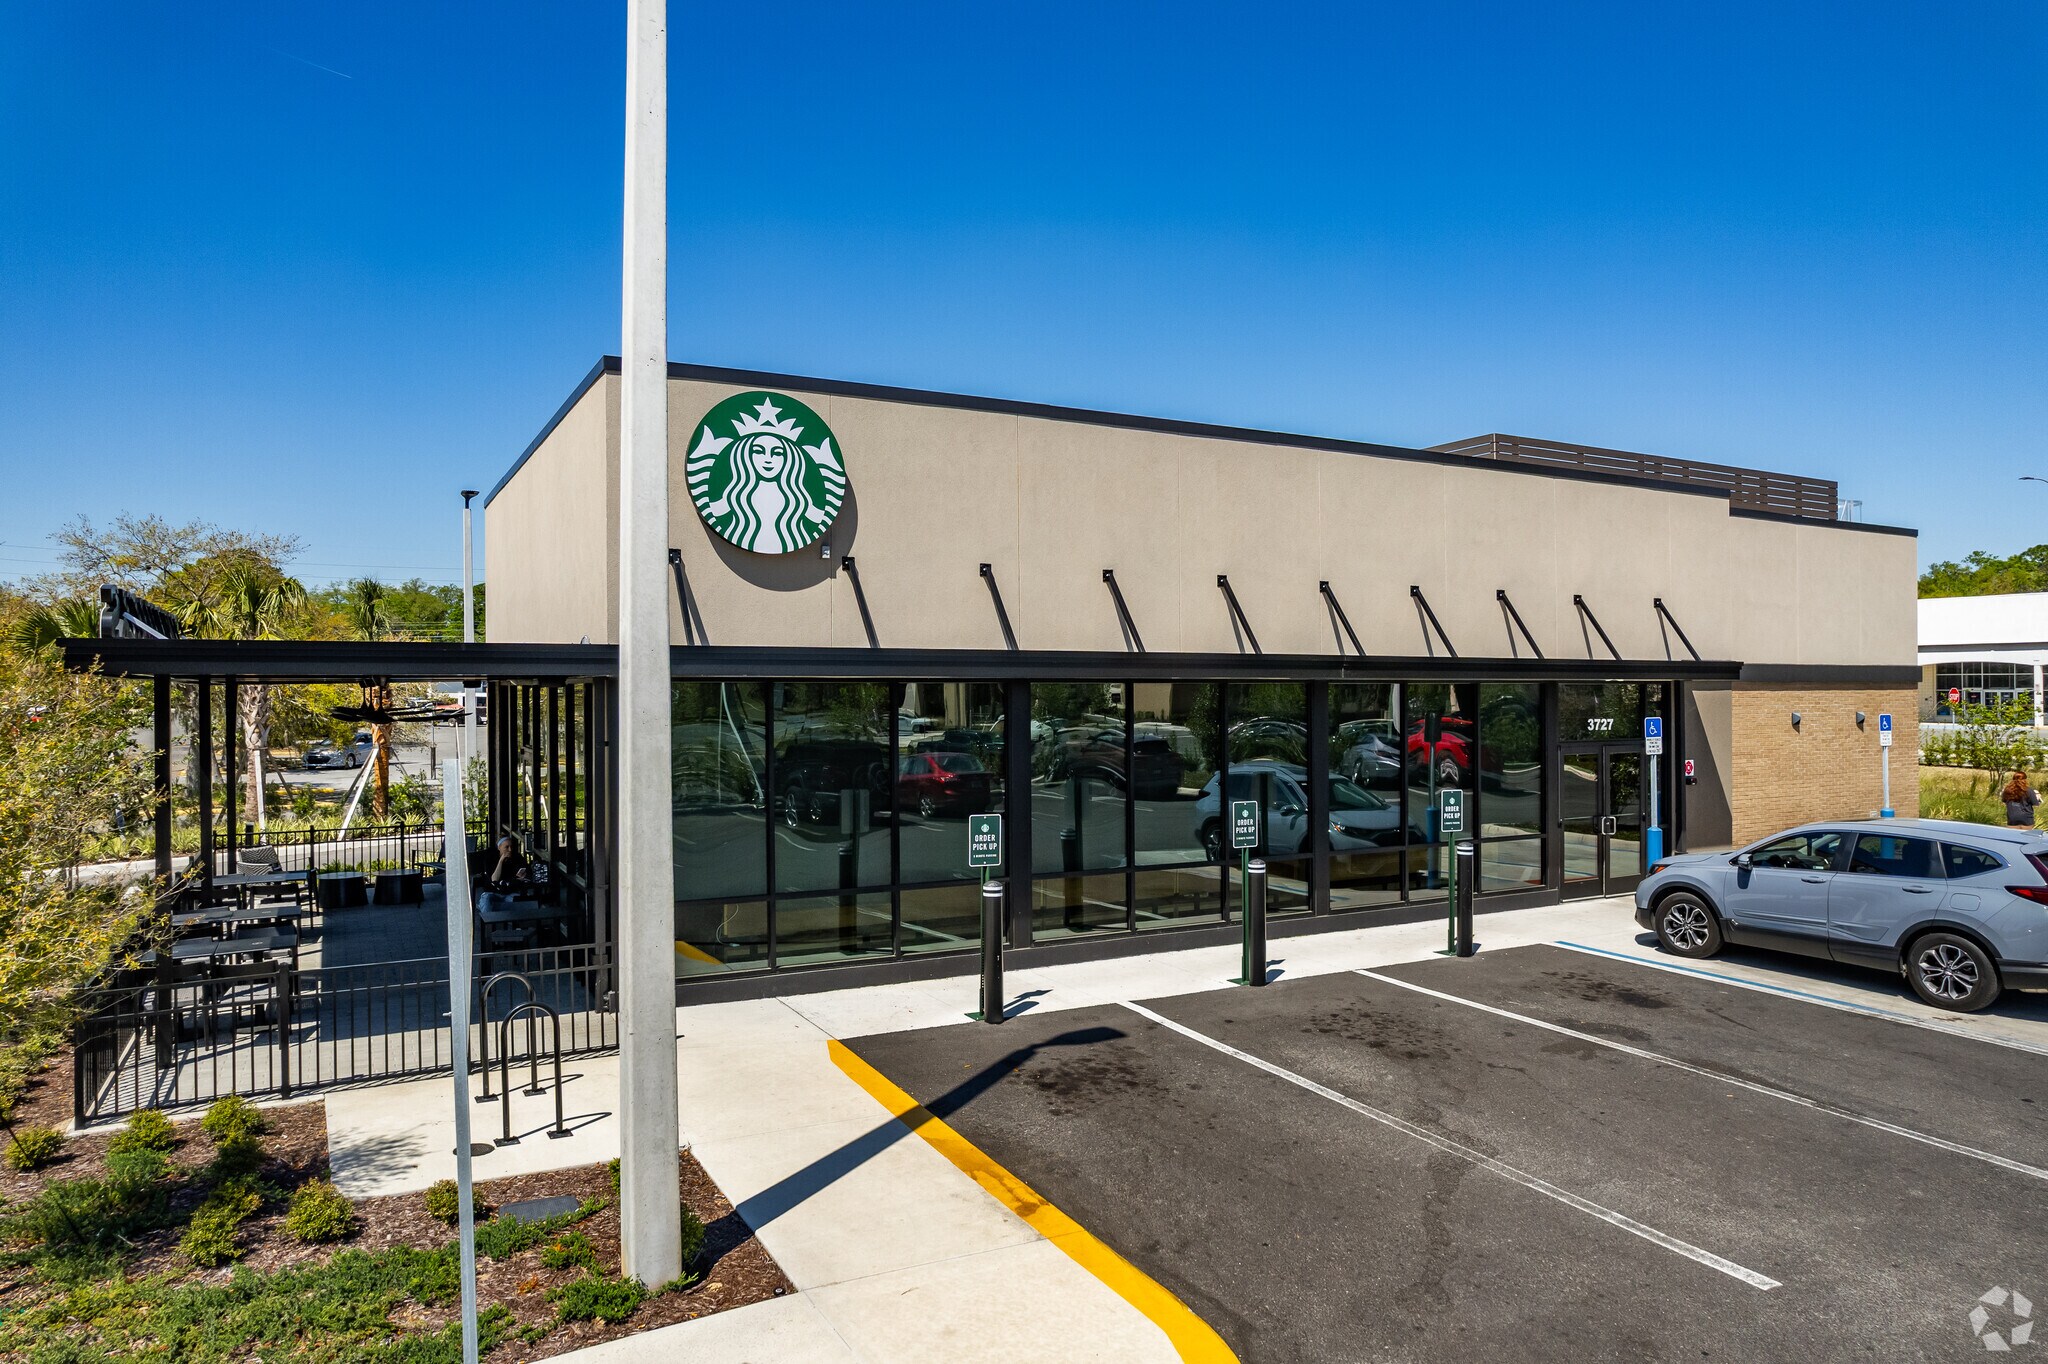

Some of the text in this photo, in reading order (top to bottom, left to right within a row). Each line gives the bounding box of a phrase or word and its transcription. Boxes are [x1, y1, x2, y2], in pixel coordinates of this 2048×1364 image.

[1587, 718, 1614, 731] 3727
[1237, 818, 1254, 826] ORDER
[974, 834, 996, 842] ORDER
[972, 842, 998, 851] PICK UP
